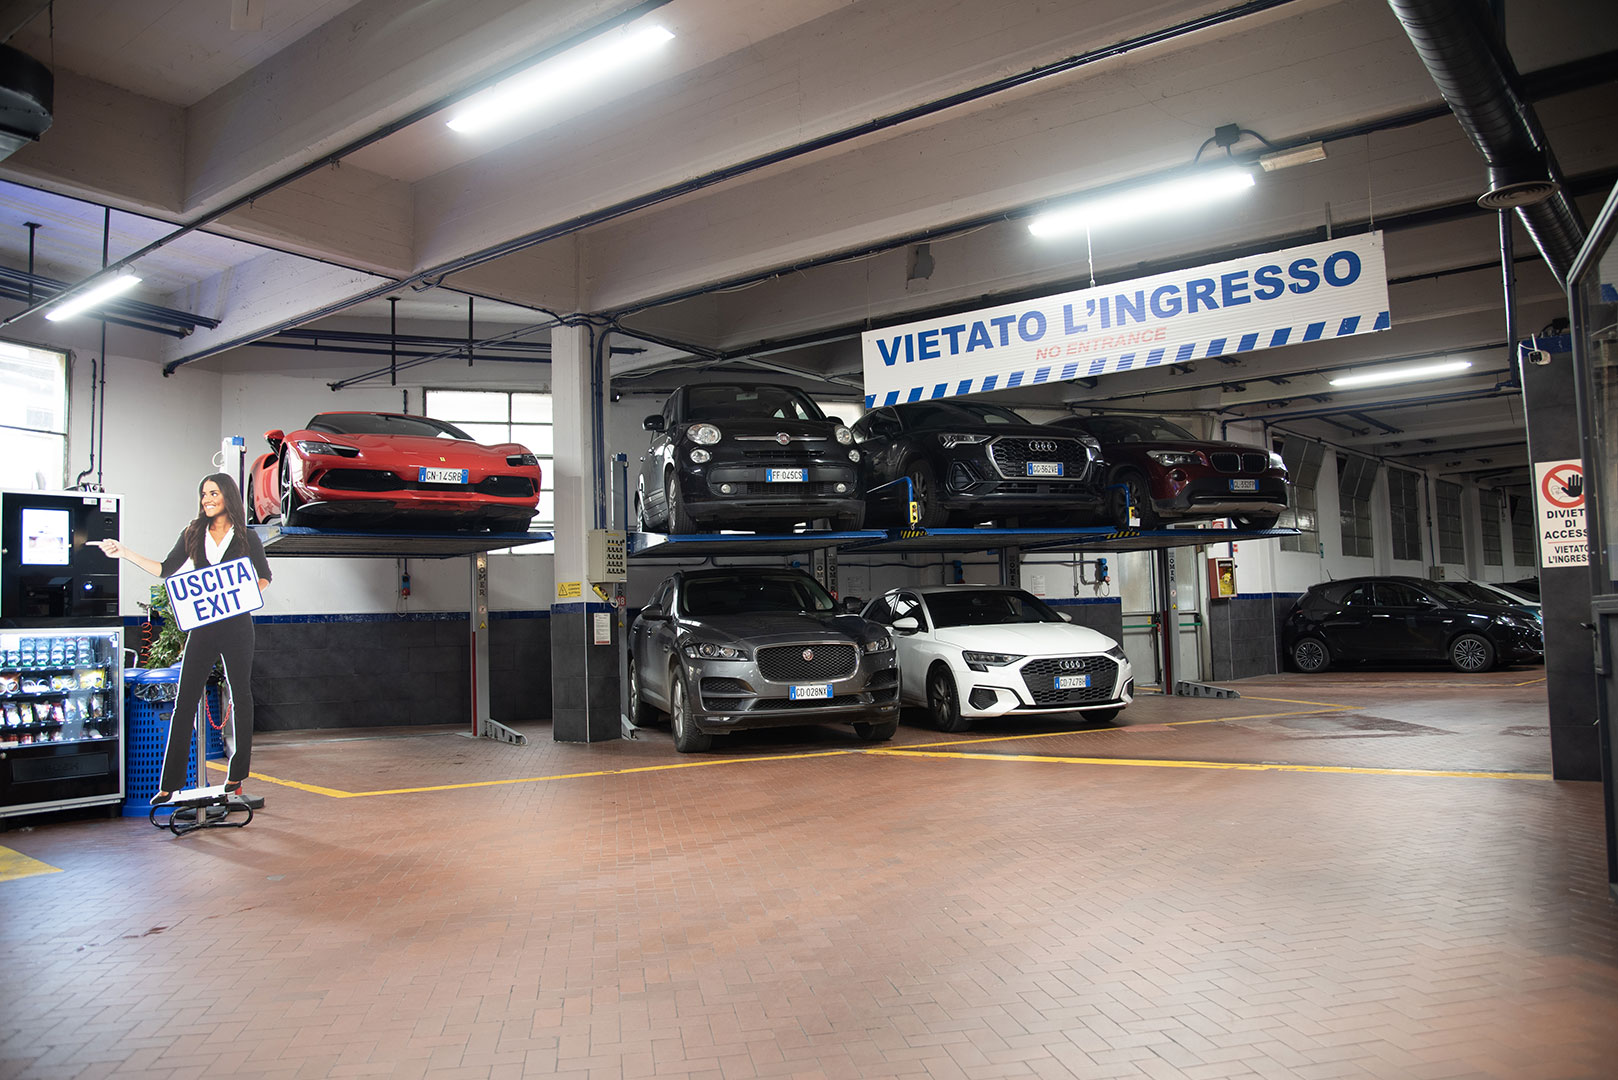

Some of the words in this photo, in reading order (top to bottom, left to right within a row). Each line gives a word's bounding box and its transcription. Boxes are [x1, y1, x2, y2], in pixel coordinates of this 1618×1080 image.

[876, 310, 1047, 366] VIETATO
[1063, 250, 1362, 335] L'INGRESSO
[1036, 345, 1061, 360] NO
[1066, 327, 1167, 355] ENTRANCE
[1546, 508, 1585, 519] DIVIET
[1565, 519, 1576, 528] DI
[1544, 528, 1588, 539] ACCESS
[1548, 553, 1588, 563] L'INGRES
[171, 561, 252, 601] USCITA
[193, 588, 241, 621] EXIT
